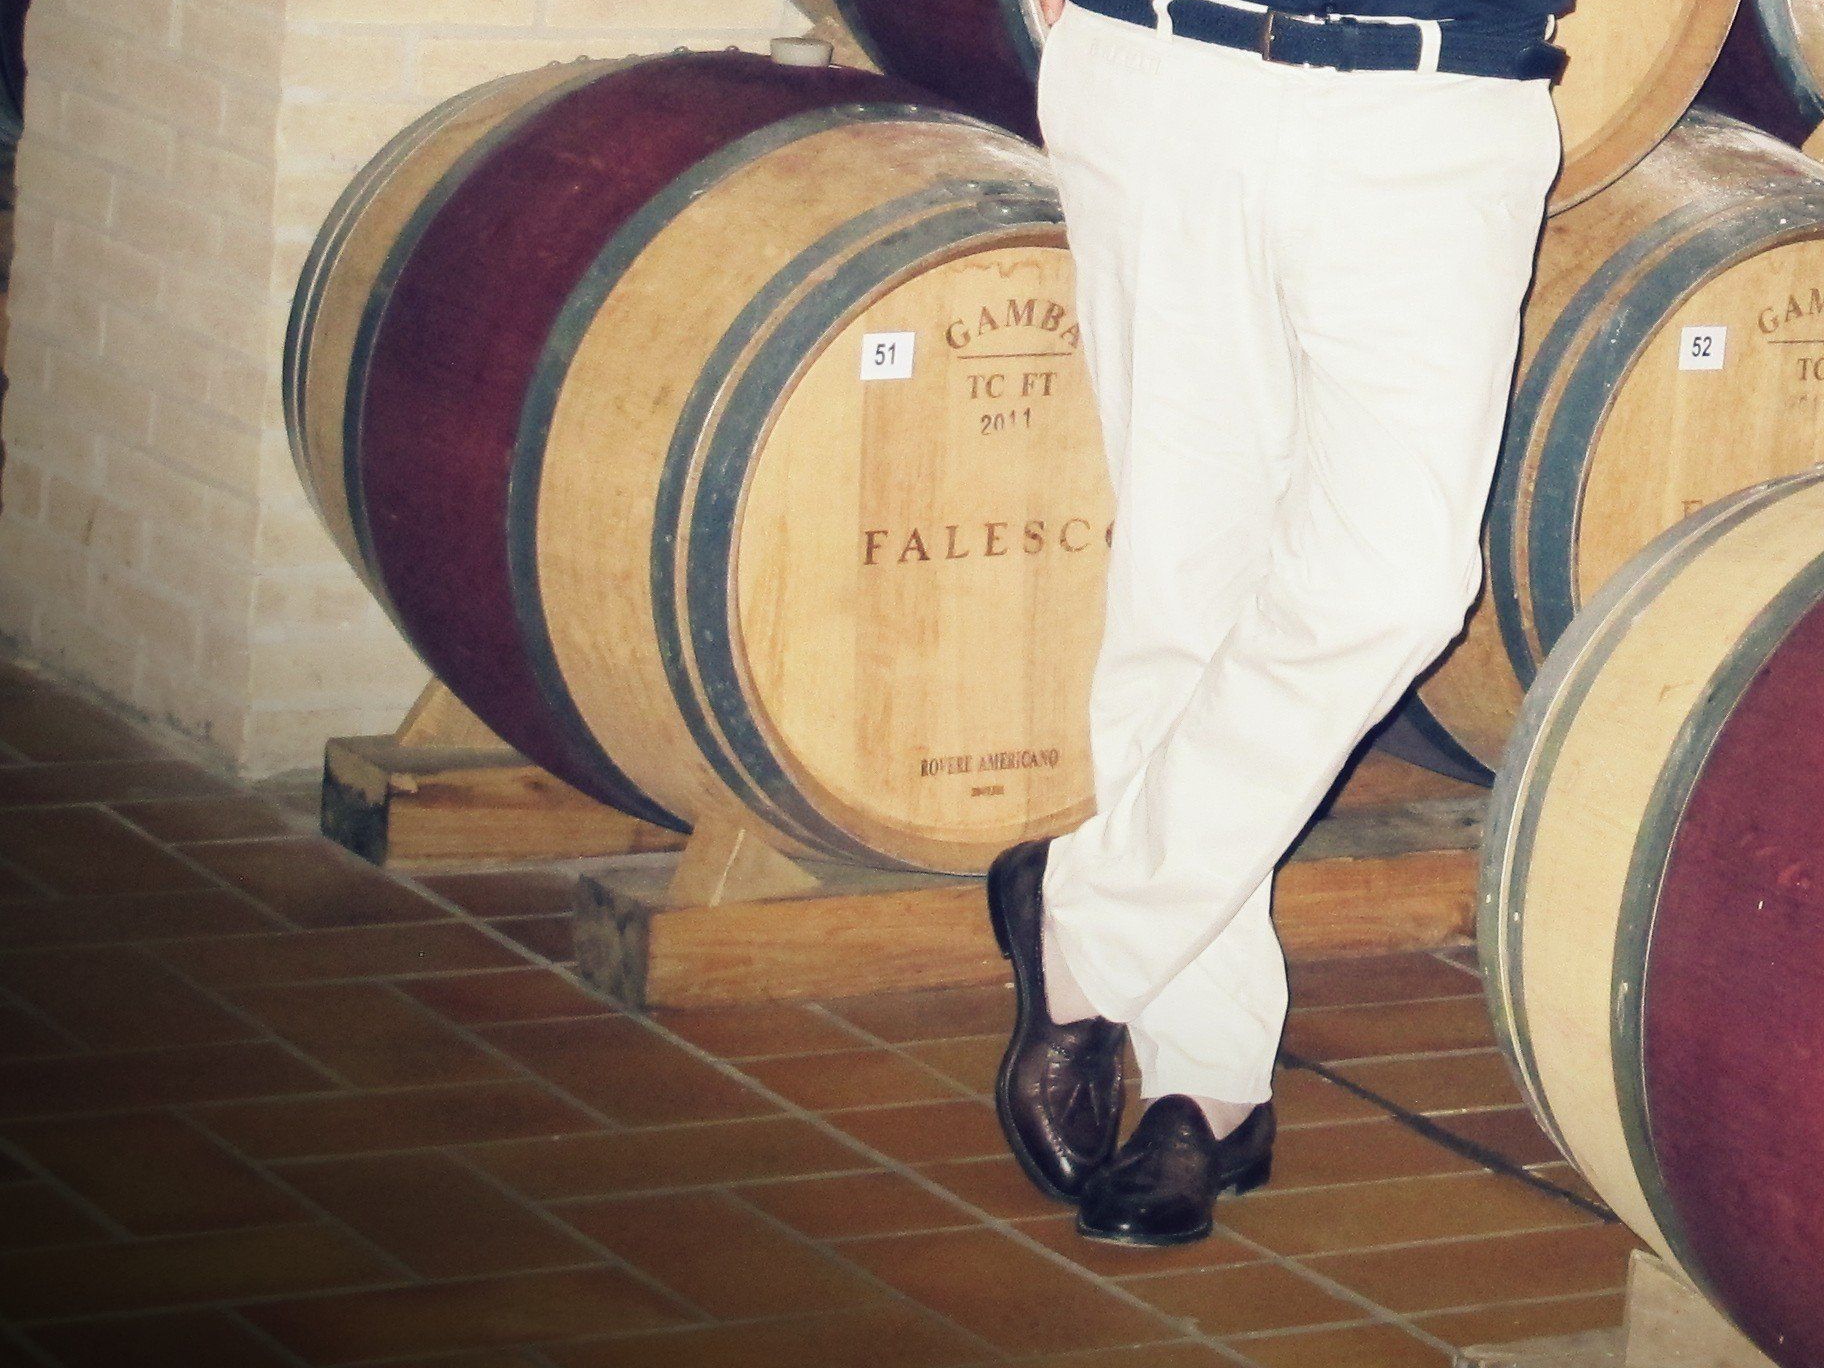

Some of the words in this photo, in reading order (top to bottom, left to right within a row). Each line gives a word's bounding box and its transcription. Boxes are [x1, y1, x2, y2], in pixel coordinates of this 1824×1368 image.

[945, 298, 1081, 349] GAMBA
[874, 342, 896, 365] 51
[1691, 336, 1712, 357] 52
[966, 373, 1005, 400] TC
[1020, 369, 1057, 397] FT
[980, 406, 1031, 435] 2011
